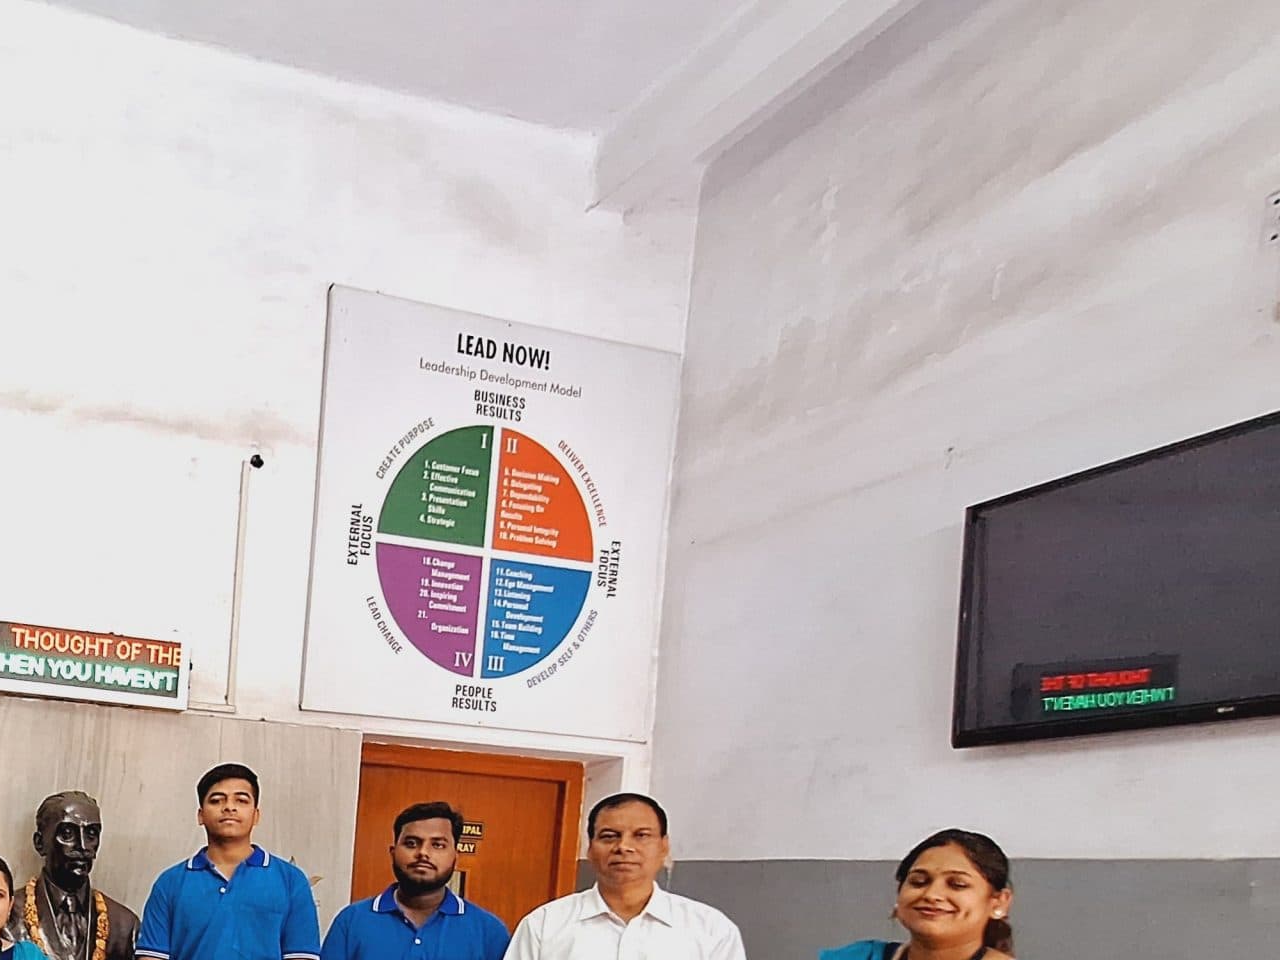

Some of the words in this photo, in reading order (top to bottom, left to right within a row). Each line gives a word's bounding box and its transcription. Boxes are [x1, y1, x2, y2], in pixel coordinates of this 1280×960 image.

[457, 332, 497, 360] LEAD
[502, 342, 550, 371] NOW!
[419, 357, 477, 381] Leadership
[480, 369, 548, 392] Development
[549, 383, 582, 398] Model
[474, 390, 526, 410] BUSINESS
[476, 403, 522, 422] RESULTS
[376, 444, 401, 480] CREATE
[398, 417, 435, 449] PURPOSE
[506, 437, 518, 454] II
[431, 472, 458, 484] Effective
[558, 439, 585, 473] DELIVER
[581, 471, 608, 528] EXCELLENCE
[347, 503, 363, 565] EXTERNAL
[360, 516, 373, 556] FOCUS
[597, 549, 610, 587] FOCUS
[606, 540, 621, 598] EXTERNAL
[430, 590, 457, 603] Inspiring
[366, 596, 381, 621] LEAD
[377, 620, 403, 655] CHANGE
[417, 610, 428, 619] 21.
[431, 622, 469, 635] Organization
[11, 626, 113, 659] THOUGHT
[116, 640, 144, 661] OF
[147, 644, 182, 667] THE
[526, 663, 558, 689] DEVELOP
[557, 647, 574, 667] SELF
[577, 609, 598, 642] OTHERS
[46, 658, 93, 682] YOU
[454, 651, 472, 668] IV
[488, 655, 505, 672] III
[455, 684, 493, 699] PEOPLE
[451, 697, 497, 712] RESULTS
